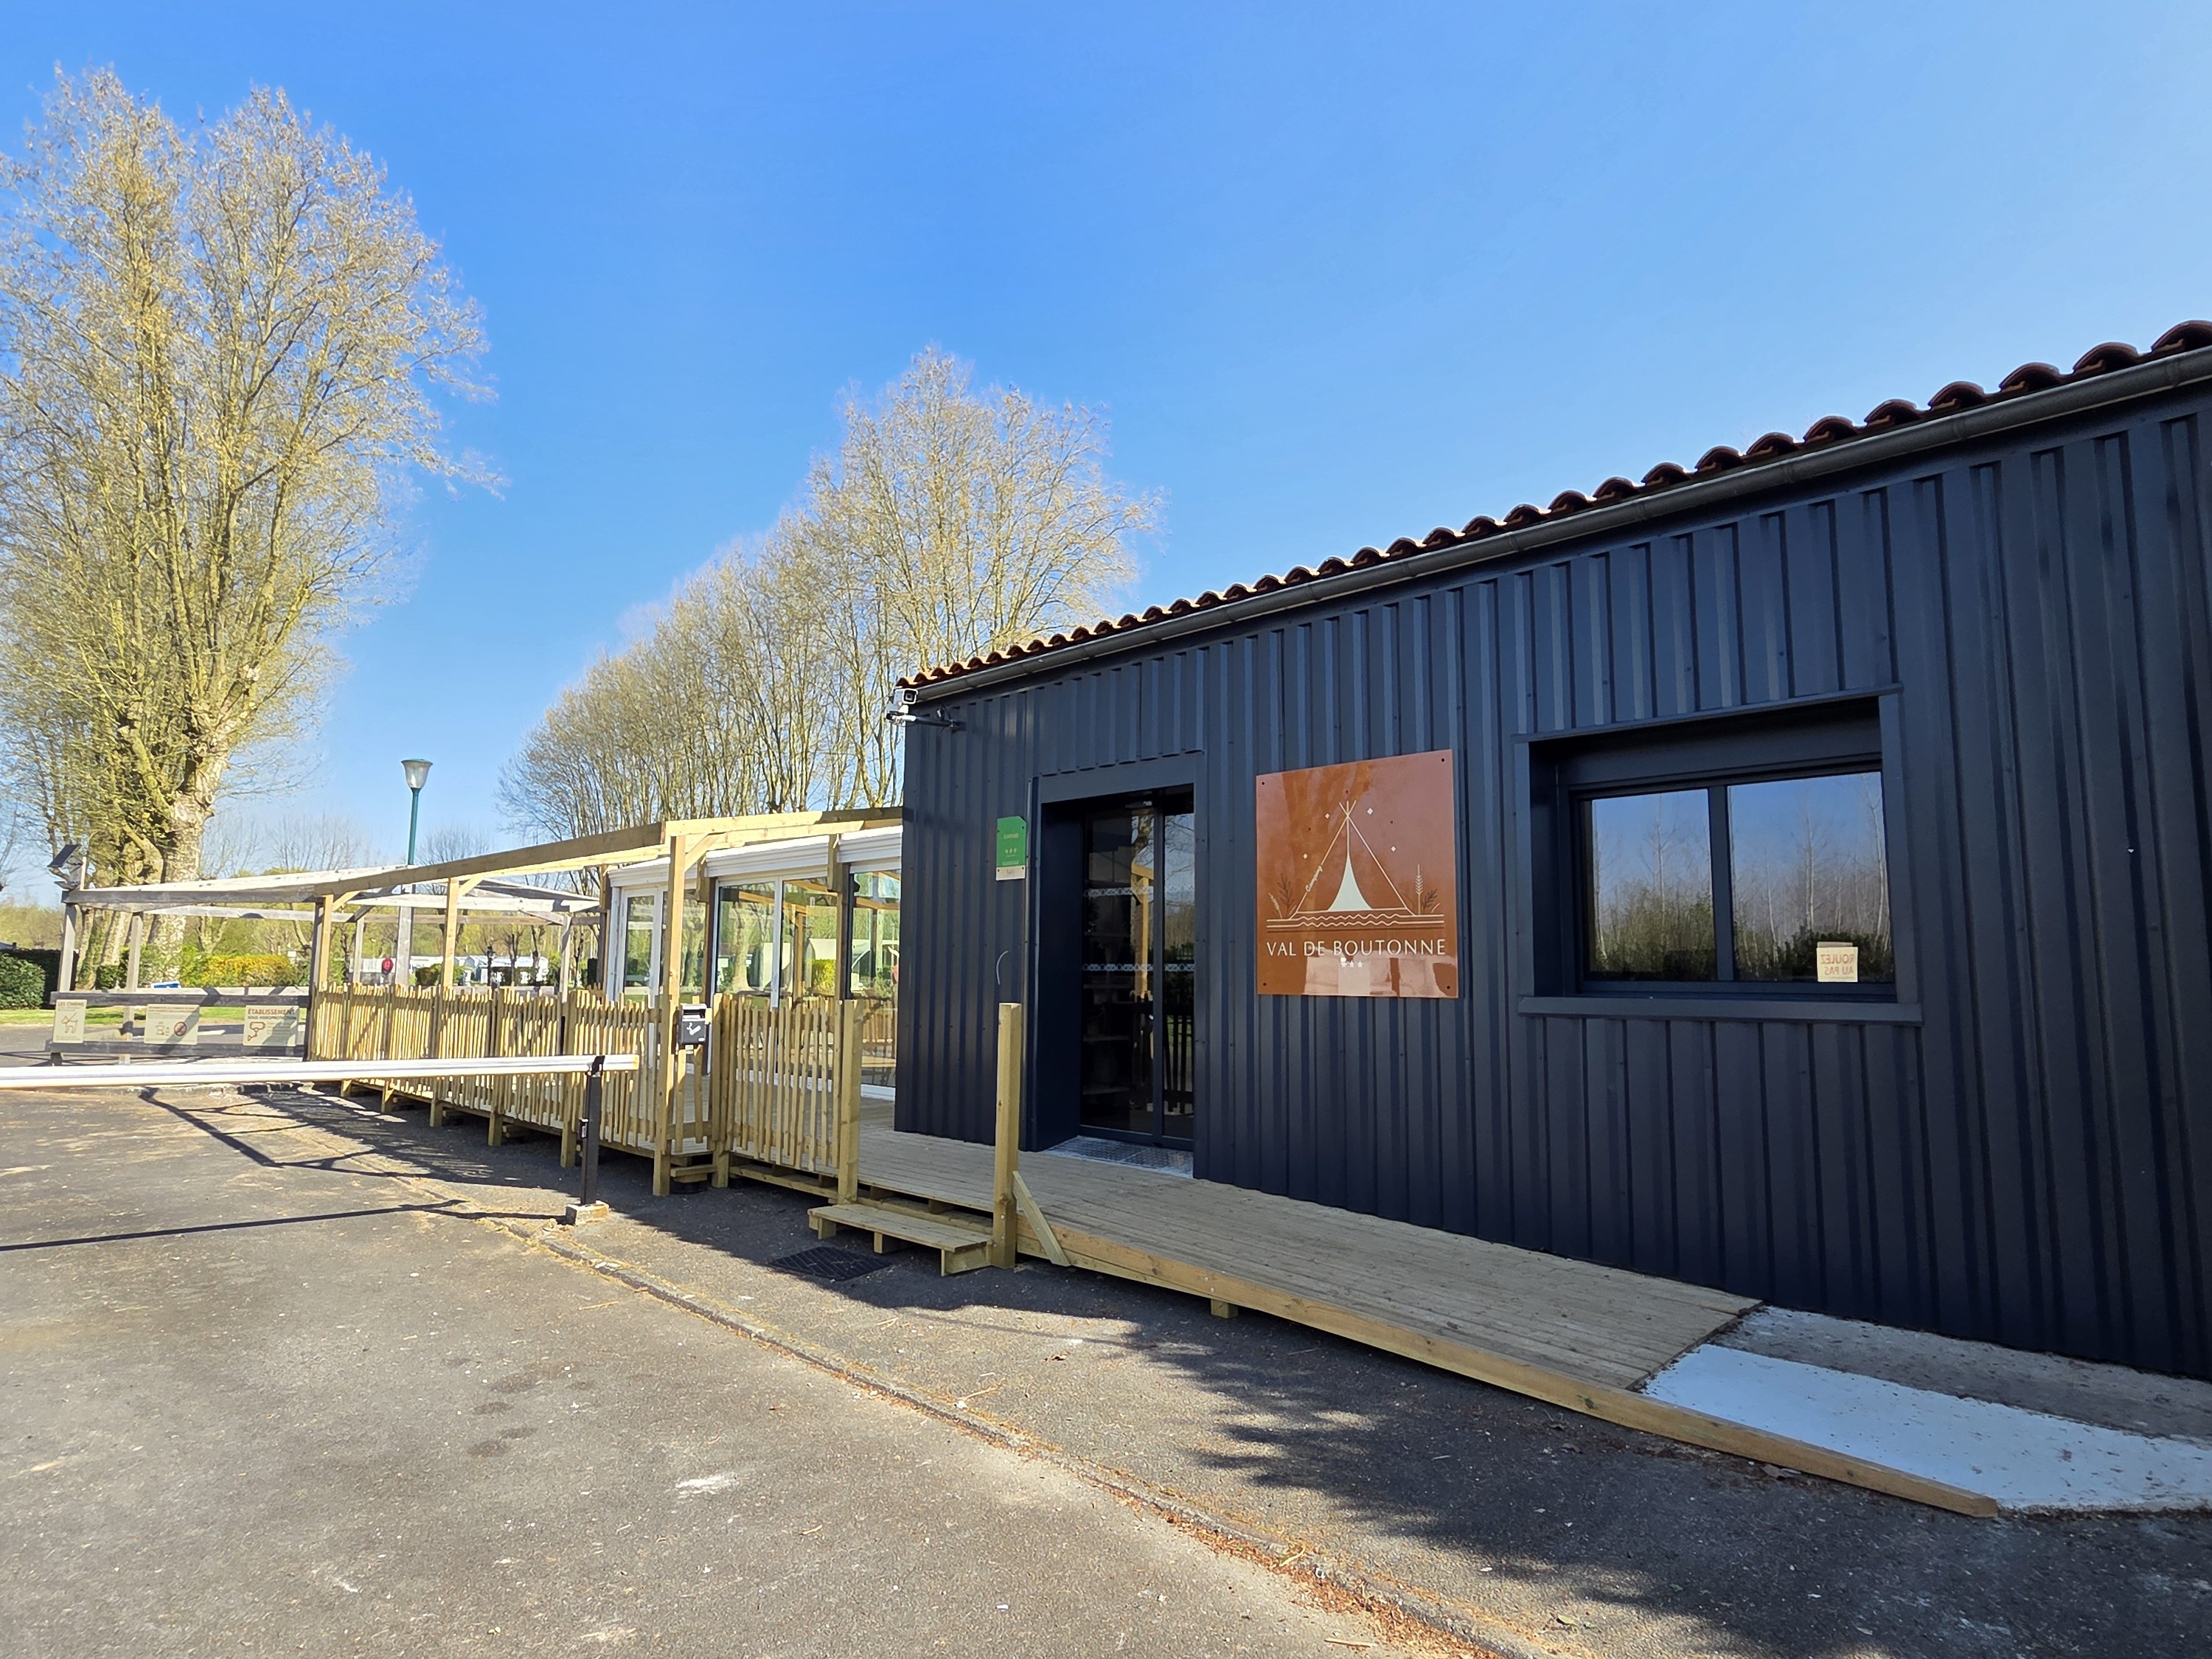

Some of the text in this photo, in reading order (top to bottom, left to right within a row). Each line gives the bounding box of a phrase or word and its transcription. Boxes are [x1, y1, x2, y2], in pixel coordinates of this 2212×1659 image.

[1266, 939, 1446, 956] VAL DE BOUTONNE
